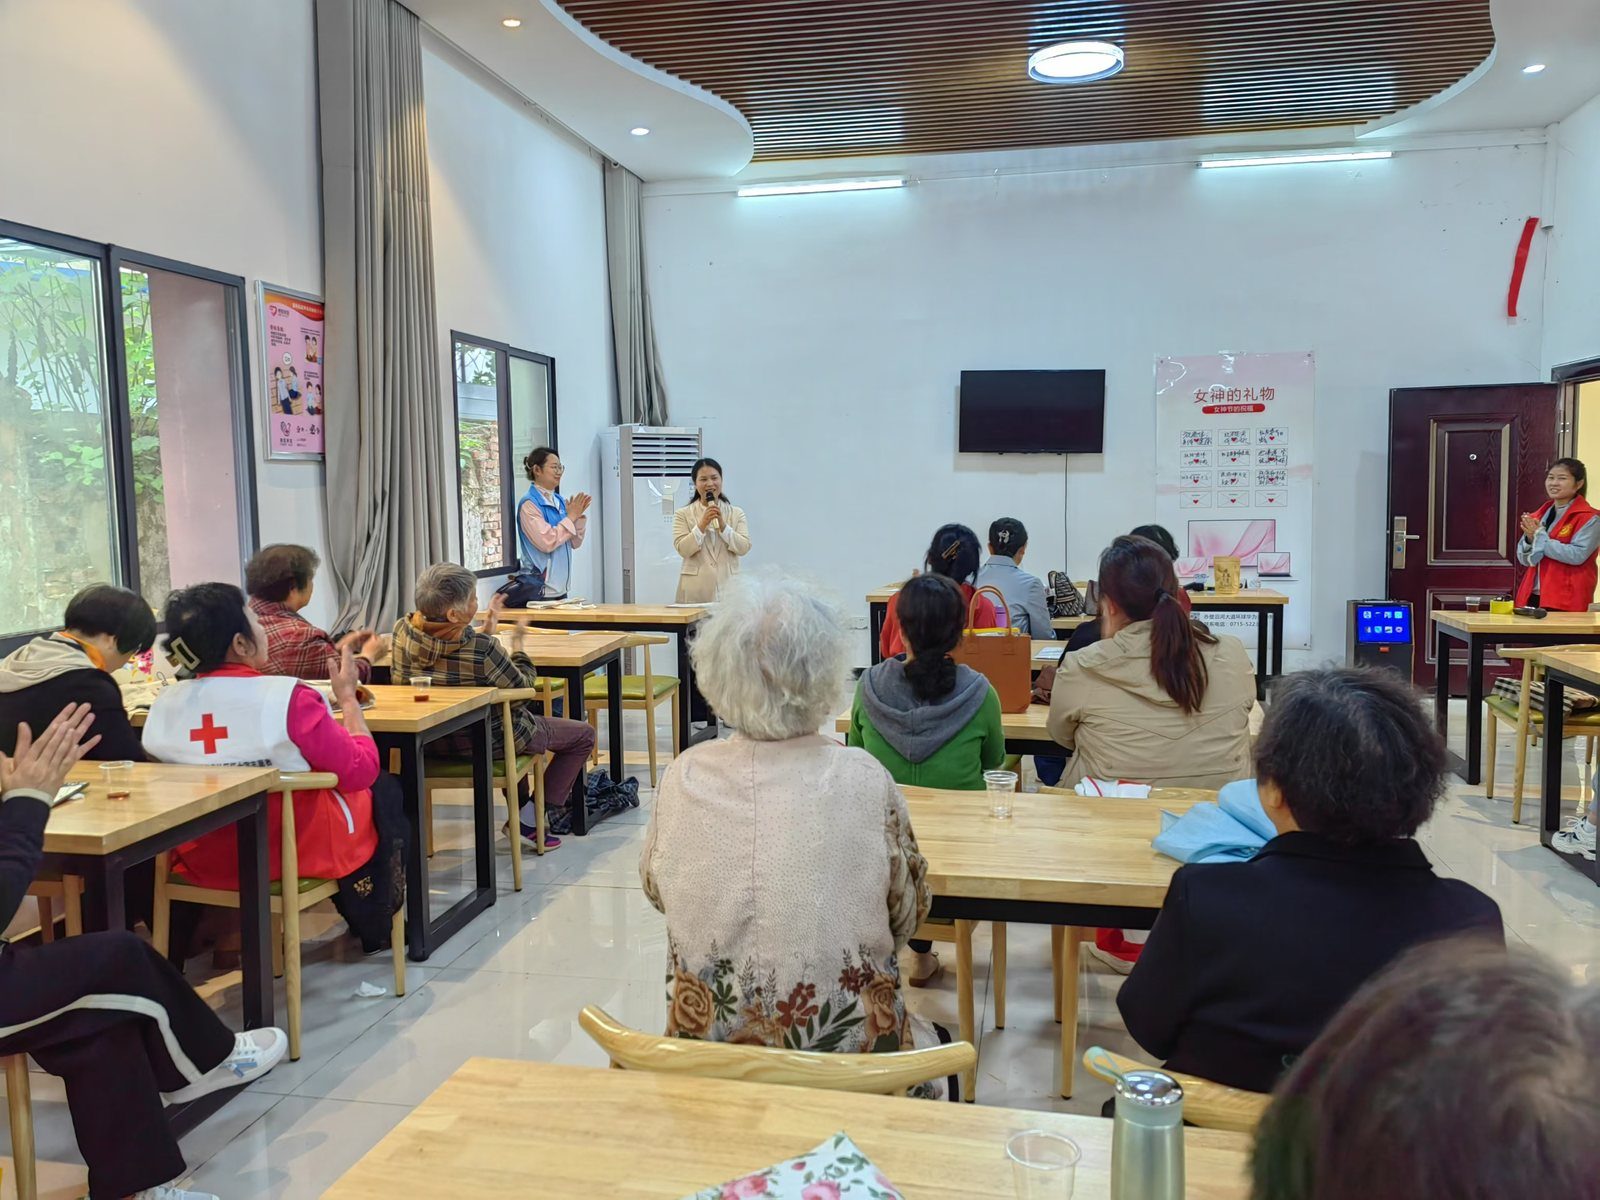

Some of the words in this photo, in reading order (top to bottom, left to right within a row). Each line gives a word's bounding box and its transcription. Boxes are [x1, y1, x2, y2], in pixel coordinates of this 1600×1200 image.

[1193, 386, 1275, 404] 女神的礼物
[1214, 404, 1254, 413] 女神节的祝福
